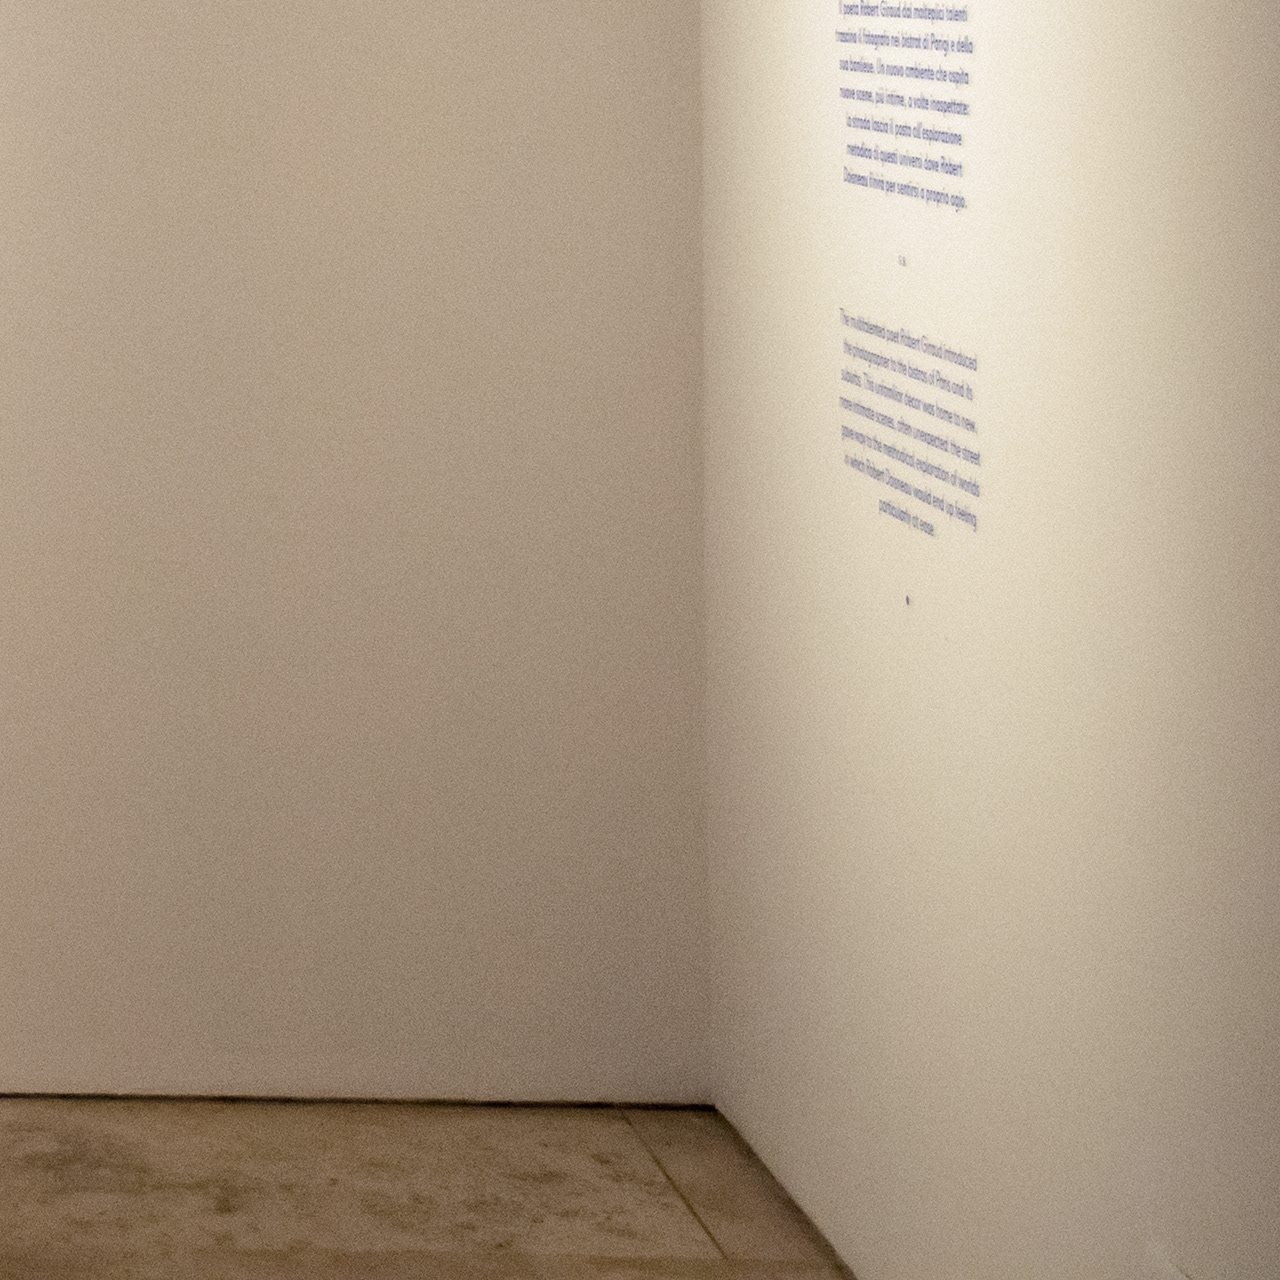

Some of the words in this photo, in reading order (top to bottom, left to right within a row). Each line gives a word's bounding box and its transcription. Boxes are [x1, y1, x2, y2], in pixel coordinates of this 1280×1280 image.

[843, 3, 859, 19] poeta
[860, 0, 879, 17] Robert
[880, 0, 901, 18] Giraud
[913, 2, 944, 24] molteplici
[945, 5, 968, 21] talenti
[862, 28, 890, 50] fotografo
[901, 30, 921, 49] bistrot
[930, 33, 949, 57] Parigi
[956, 35, 973, 54] della
[886, 63, 904, 77] nuovo
[905, 62, 935, 80] ambiente
[935, 65, 947, 82] che
[948, 67, 969, 88] ospita
[839, 87, 855, 99] nuove
[913, 93, 929, 110] volte
[852, 113, 871, 130] strada
[871, 115, 889, 133] lascia
[894, 122, 912, 139] posto
[879, 148, 898, 167] questi
[898, 149, 923, 169] universi
[923, 153, 939, 172] dove
[940, 155, 963, 177] Robert
[843, 166, 868, 187] Doisneau
[925, 187, 949, 208] proprio
[839, 307, 850, 326] The
[886, 328, 899, 344] poet
[899, 328, 920, 350] Robert
[921, 335, 943, 359] Giraud
[943, 344, 978, 372] introduced
[852, 342, 890, 368] photographer
[897, 359, 907, 376] the
[936, 370, 951, 392] Paris
[952, 379, 965, 397] and
[935, 401, 953, 424] home
[865, 458, 885, 482] Robert
[885, 468, 912, 496] Doisneau
[932, 495, 945, 512] end
[916, 457, 950, 484] exploration
[950, 469, 958, 486] of
